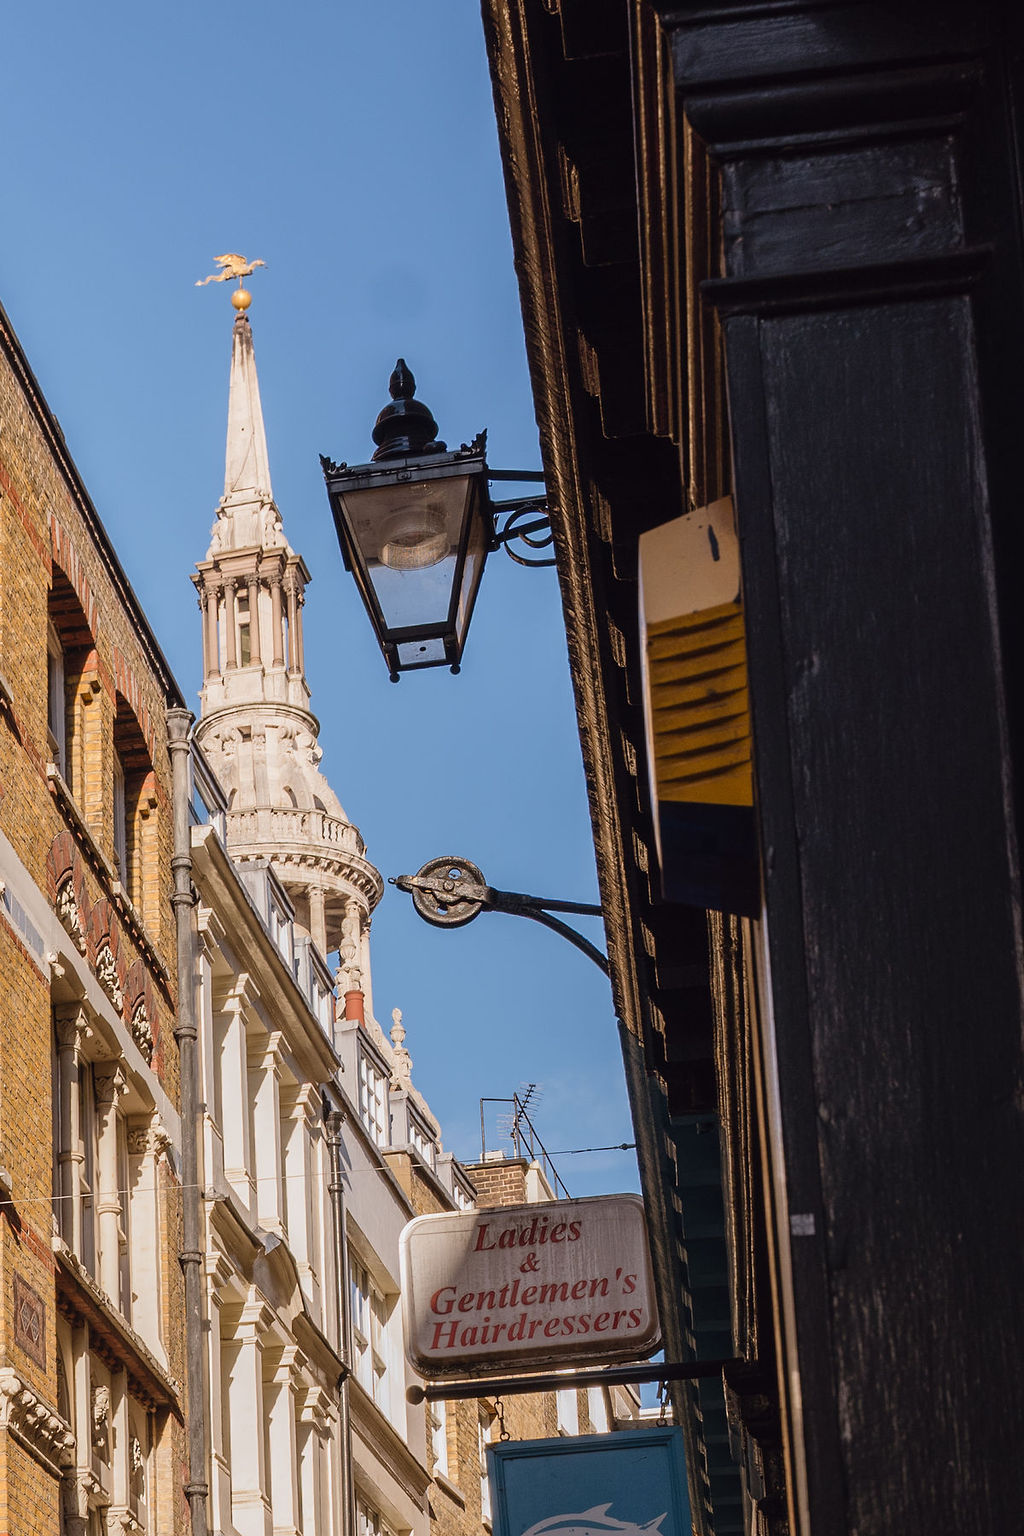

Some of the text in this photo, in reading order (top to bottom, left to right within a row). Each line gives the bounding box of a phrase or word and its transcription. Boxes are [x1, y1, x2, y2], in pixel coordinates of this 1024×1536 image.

[473, 1216, 582, 1252] Ladies
[519, 1252, 541, 1274] &
[430, 1267, 638, 1316] Gentlemen's
[430, 1306, 643, 1350] Hairdressers
